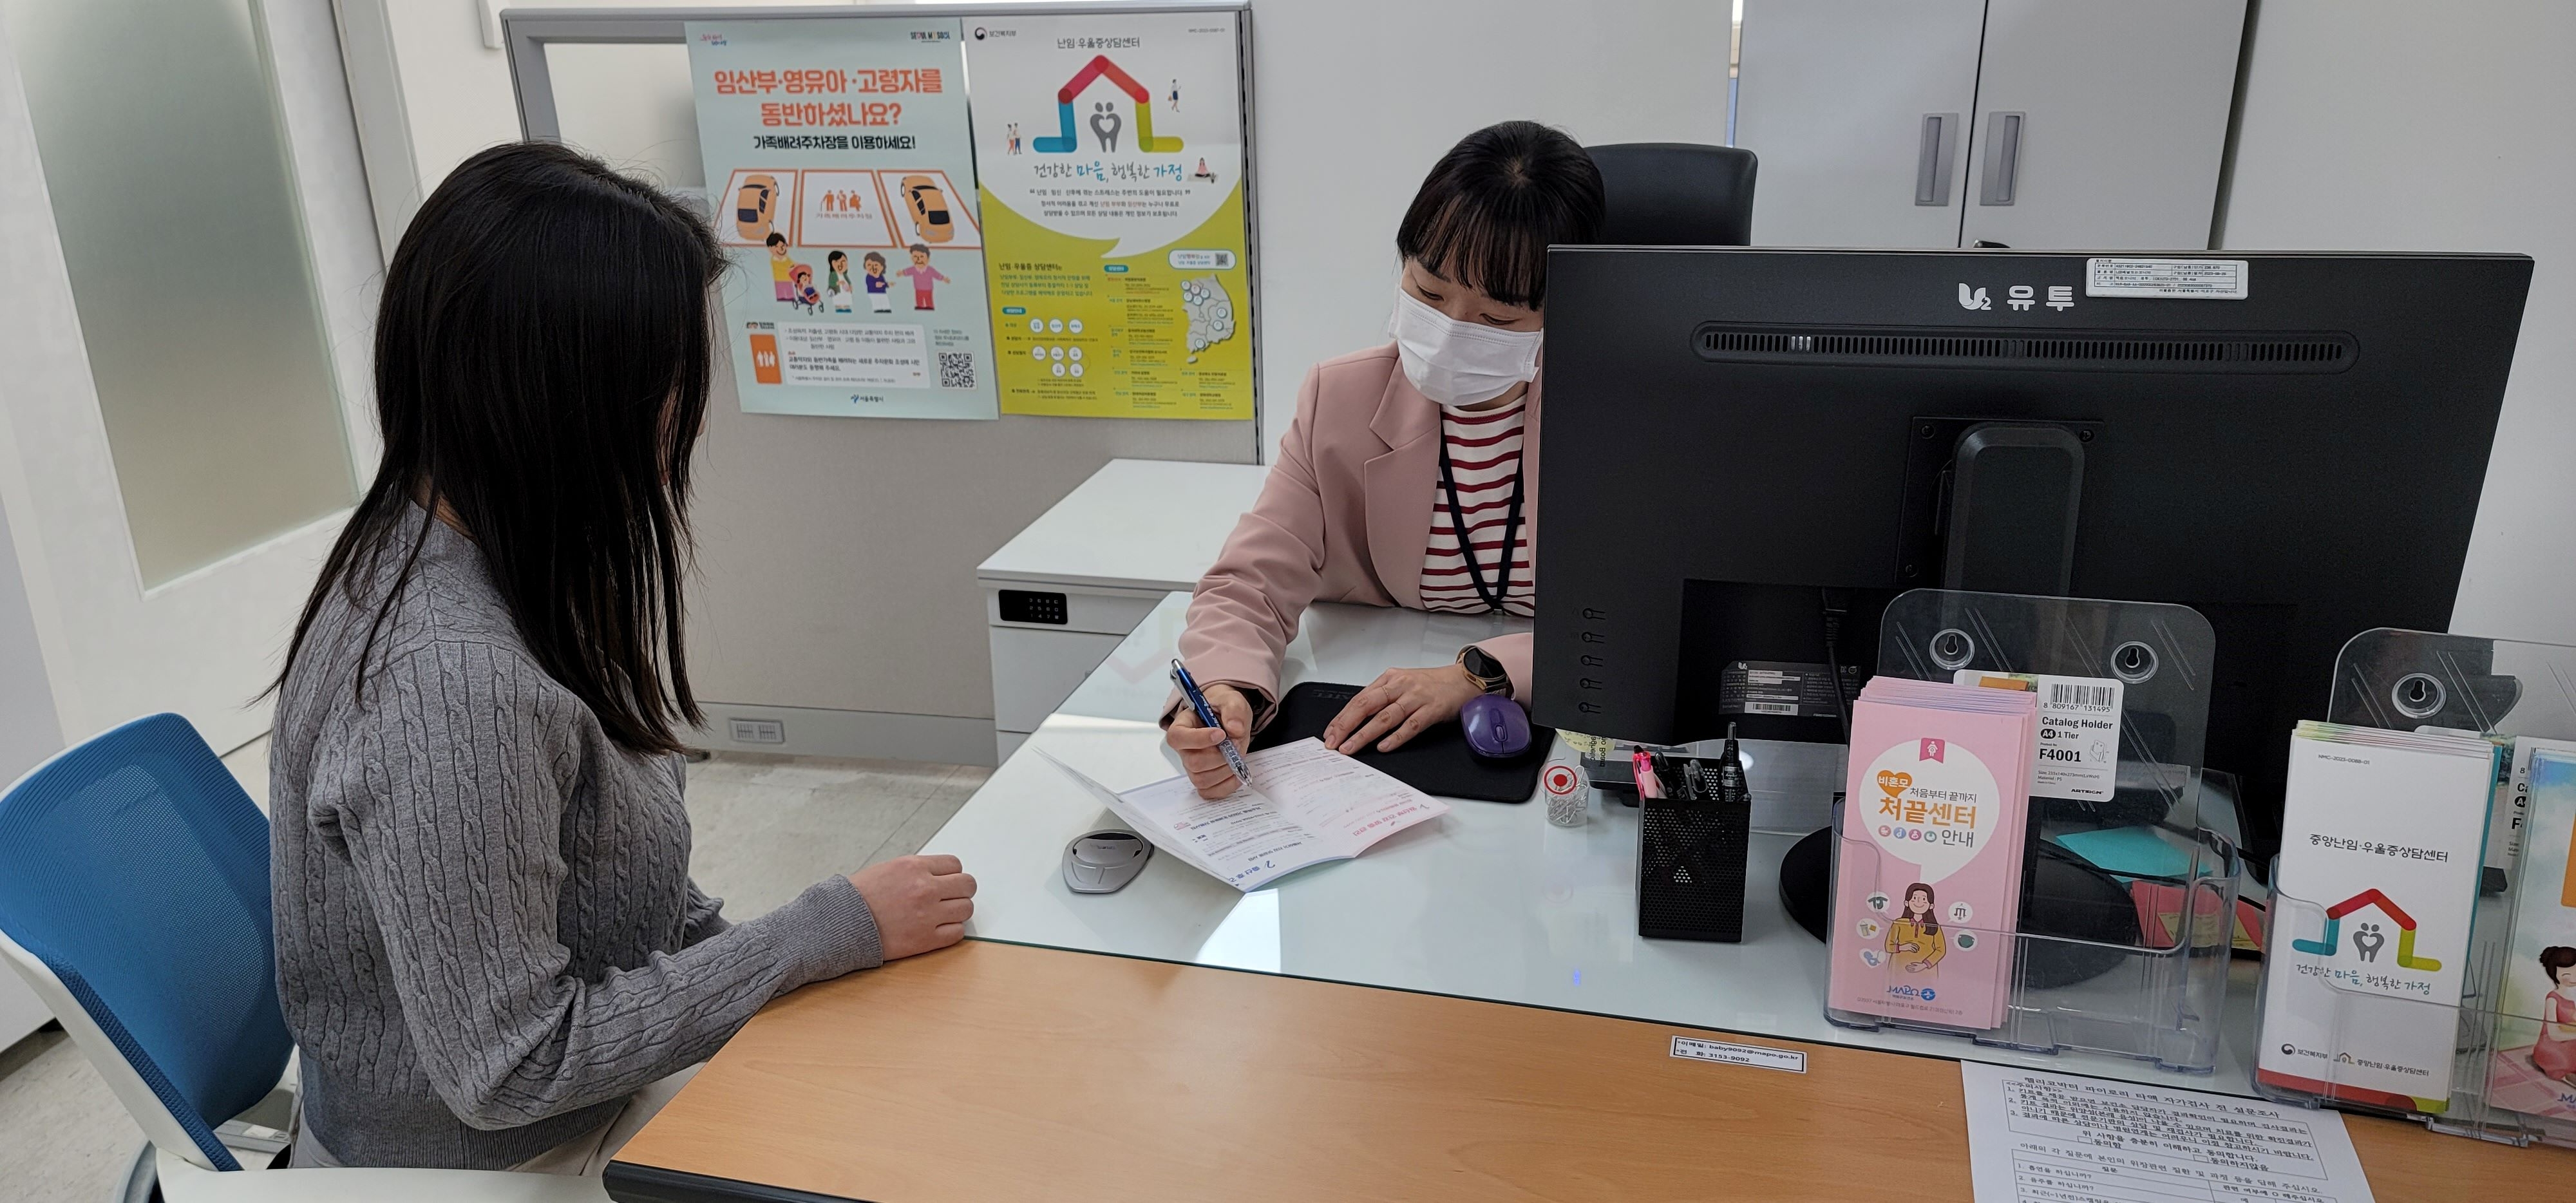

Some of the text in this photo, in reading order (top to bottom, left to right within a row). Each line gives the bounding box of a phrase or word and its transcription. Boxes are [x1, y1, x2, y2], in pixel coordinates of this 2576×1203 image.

[714, 69, 846, 95] 임산부·영유아
[761, 102, 902, 127] 동반하셨나요?
[753, 136, 916, 151] 가족배려주차장을 이용하세요!
[1034, 160, 1182, 183] 건강한 마음, 행복한 가정
[2052, 703, 2079, 711] 809167
[2041, 716, 2114, 730] Catalog Holder
[2042, 730, 2054, 738] A4
[2063, 731, 2079, 739] Tier
[2039, 748, 2081, 763] F4001
[1878, 775, 1909, 788] 비혼모
[1909, 787, 1977, 804] 처음부터 끝까지
[1878, 797, 1976, 829] 처끝센터
[1941, 829, 1975, 848] 안내
[2309, 833, 2448, 863] 중앙난임·우울증상담센터
[2295, 963, 2431, 996] 건강한 마음, 행복한 가정
[2297, 1048, 2329, 1059] 보건복지부
[2019, 1088, 2043, 1096] 키트를
[2131, 1104, 2166, 1115] 담당자가
[2261, 1123, 2307, 1134] 검사결과는
[2234, 1107, 2279, 1118] 설문조사
[2163, 1142, 2203, 1153] 이해하고
